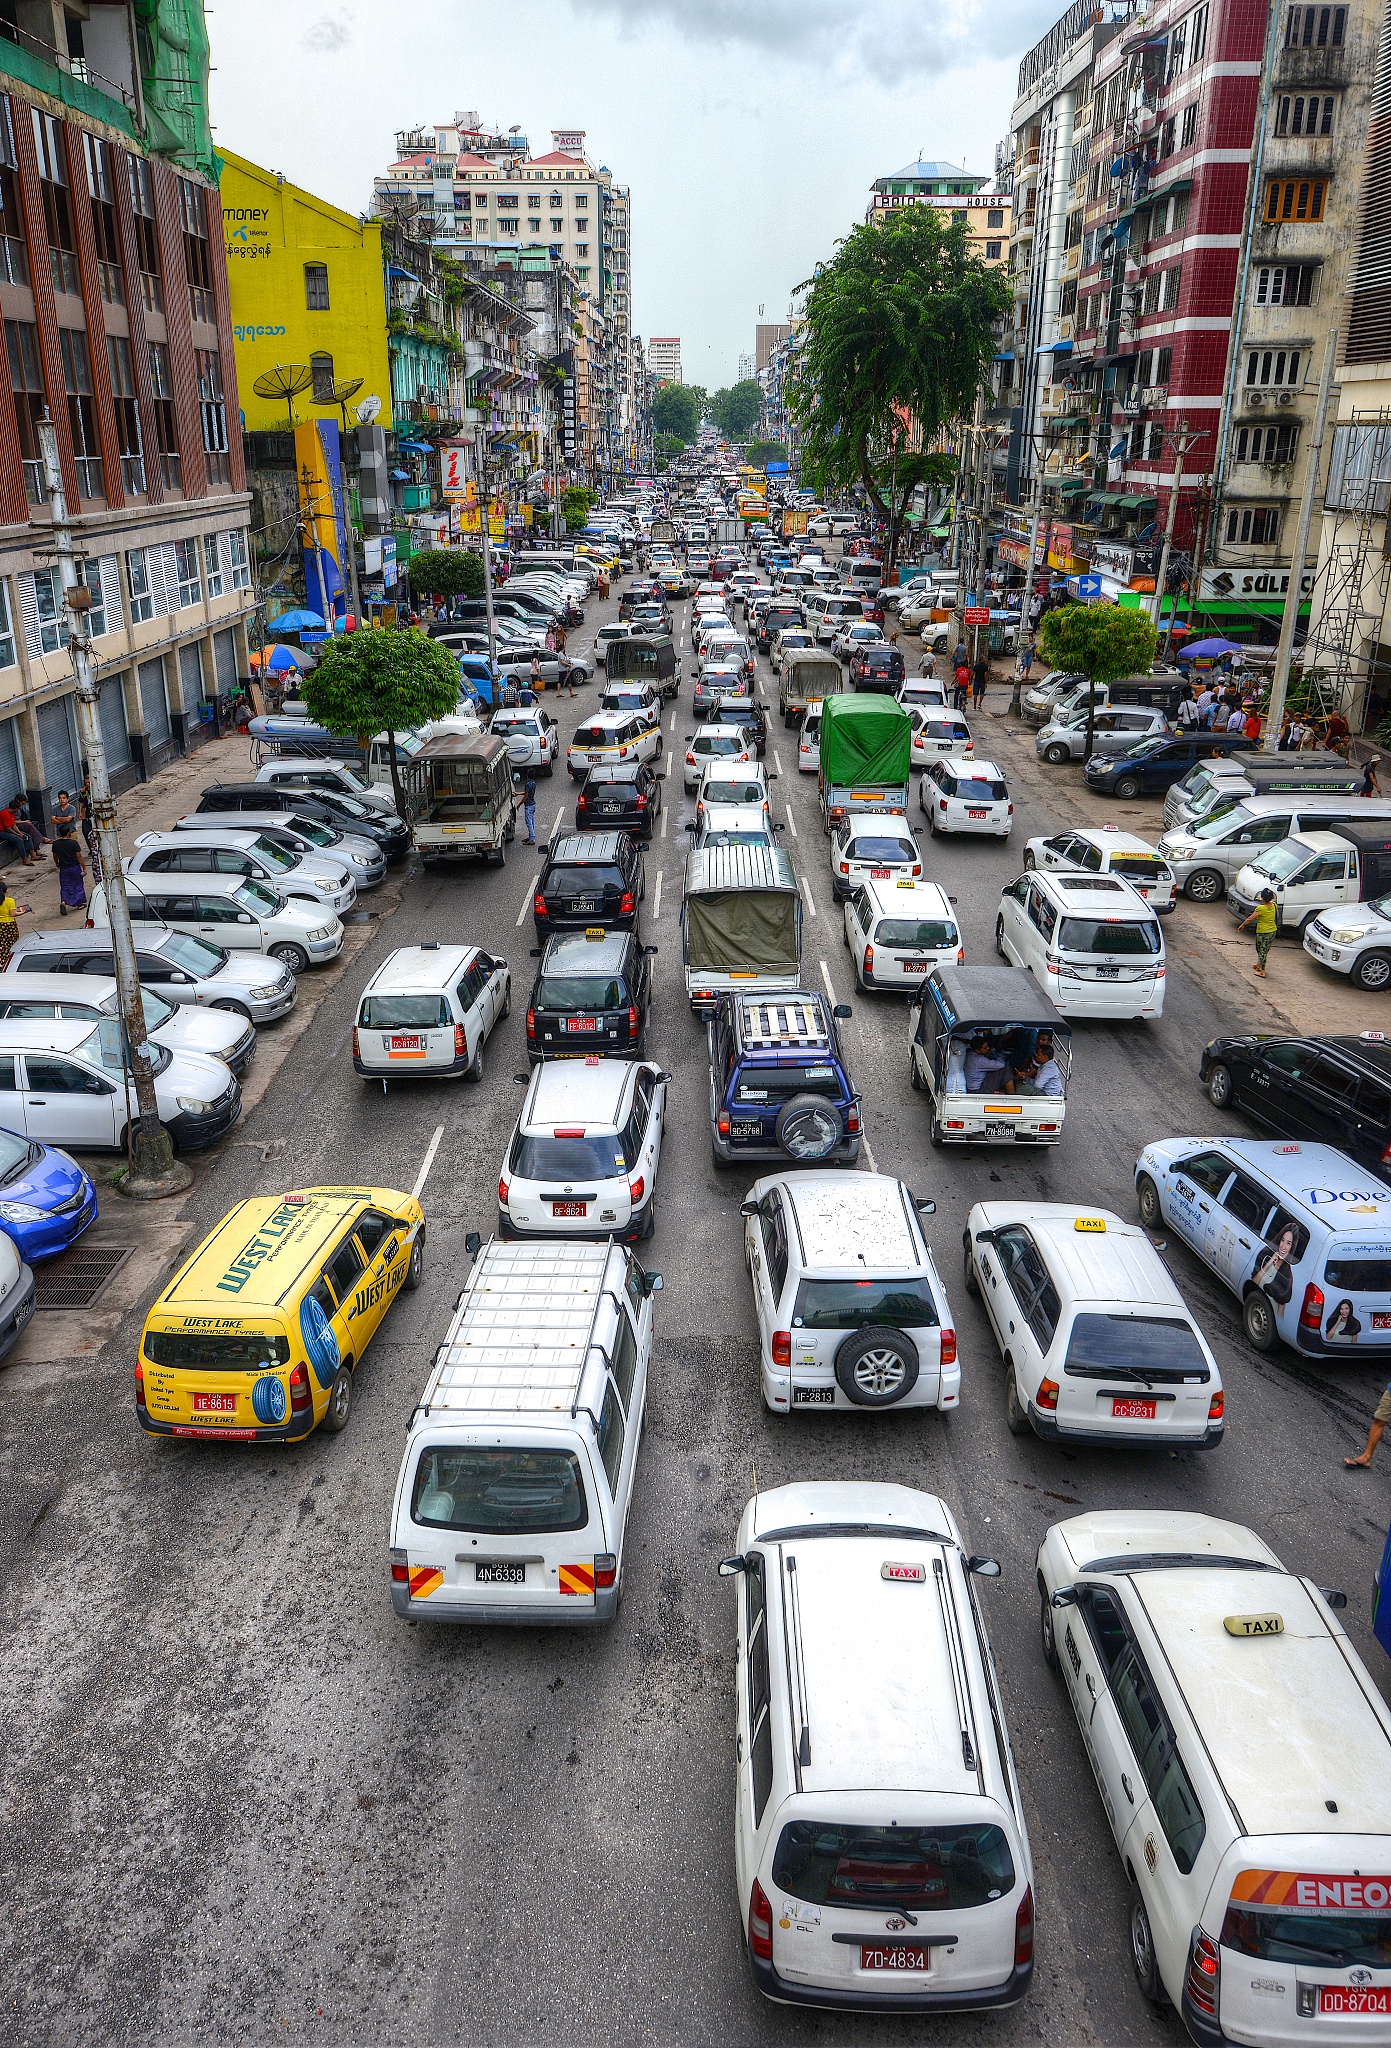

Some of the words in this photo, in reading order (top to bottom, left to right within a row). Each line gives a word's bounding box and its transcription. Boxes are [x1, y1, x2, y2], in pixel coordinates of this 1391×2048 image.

[560, 137, 582, 145] ACCU
[967, 197, 1003, 207] HOUSE
[222, 208, 269, 221] money
[732, 1127, 760, 1135] 9D-5768
[1301, 1187, 1391, 1204] Dove
[1081, 1220, 1102, 1228] TAXI
[216, 1238, 273, 1294] WEST
[355, 1279, 386, 1317] WEST
[386, 1262, 407, 1295] LAKE
[183, 1318, 213, 1328] WEST
[214, 1319, 243, 1329] LAKE
[164, 1326, 231, 1335] PERFORMANCE
[796, 1392, 832, 1402] 1F-2813
[197, 1398, 233, 1410] 1E-8615
[1114, 1405, 1153, 1417] CC-9231
[478, 1567, 524, 1582] 4N-6338
[890, 1567, 920, 1578] TAXI
[1242, 1619, 1279, 1634] TAXI
[1297, 1880, 1391, 1907] ENEO
[865, 1951, 925, 1969] 7D-4834
[1323, 1993, 1388, 2012] DD-8704
